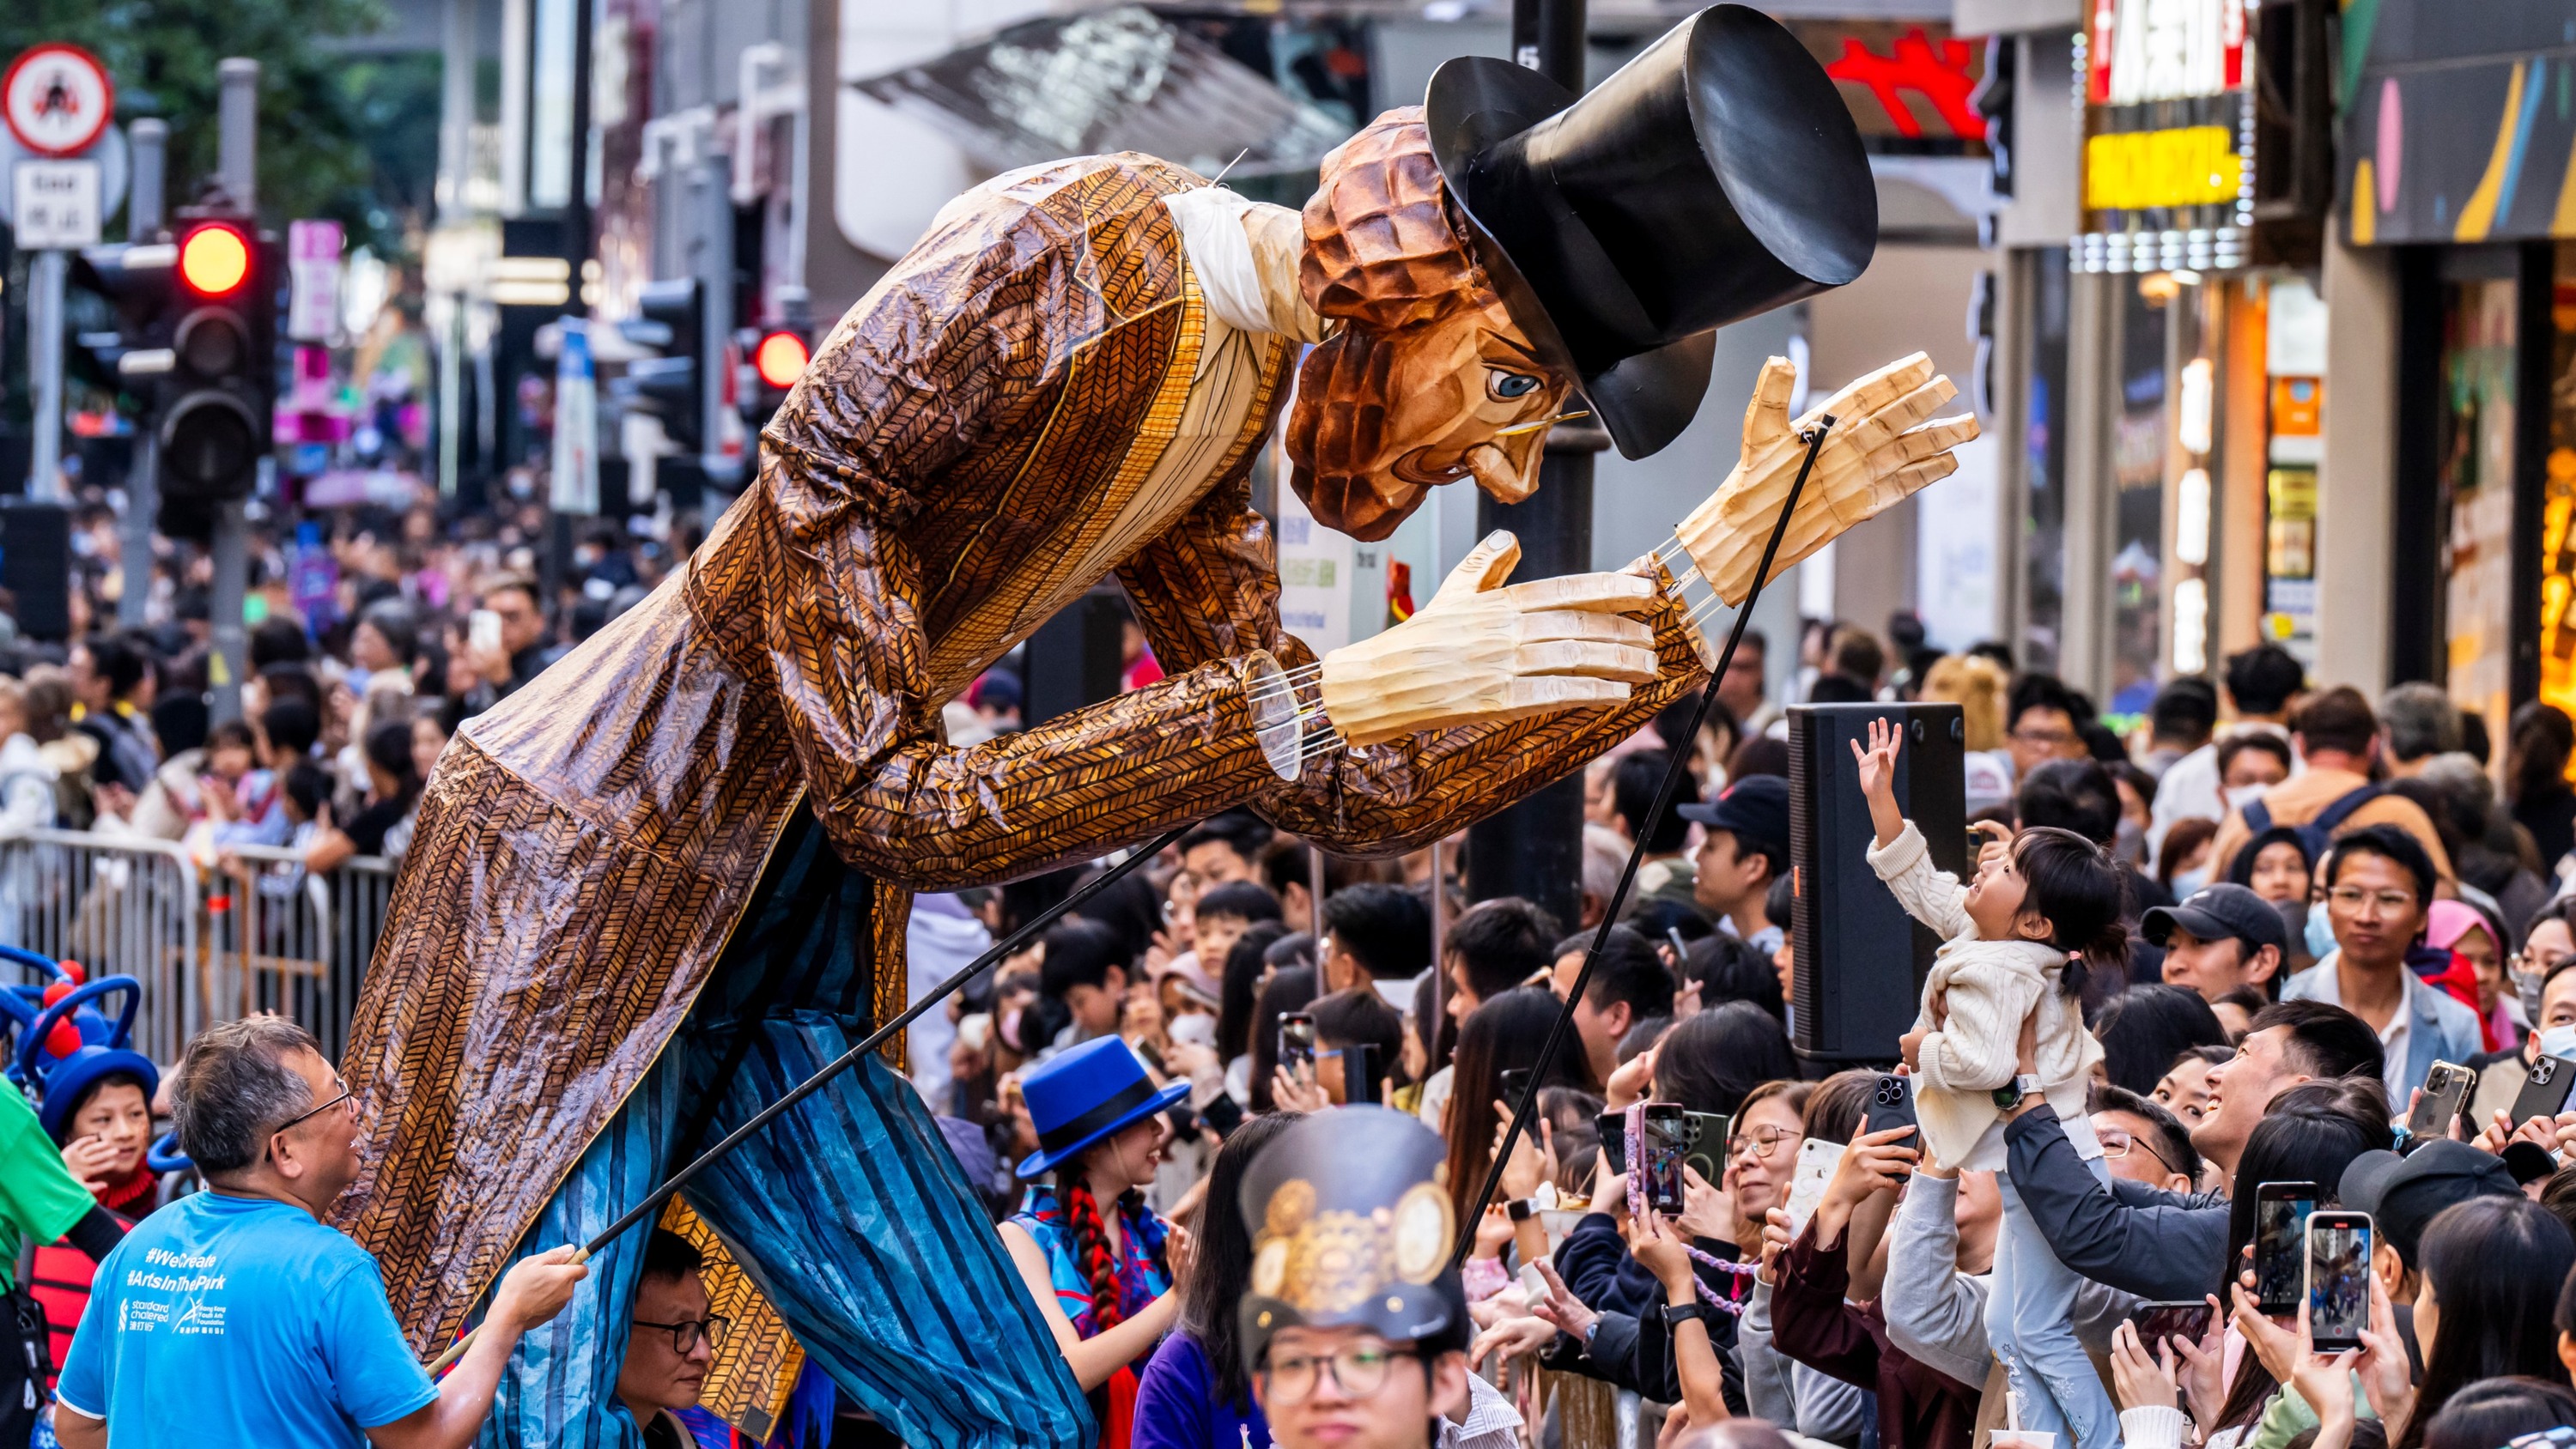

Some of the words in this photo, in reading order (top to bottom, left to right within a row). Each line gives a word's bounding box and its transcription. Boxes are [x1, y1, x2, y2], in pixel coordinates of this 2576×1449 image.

[145, 1247, 216, 1269] #WeCreate
[127, 1270, 226, 1291] #ArtsInThePark
[131, 1309, 169, 1322] chatered
